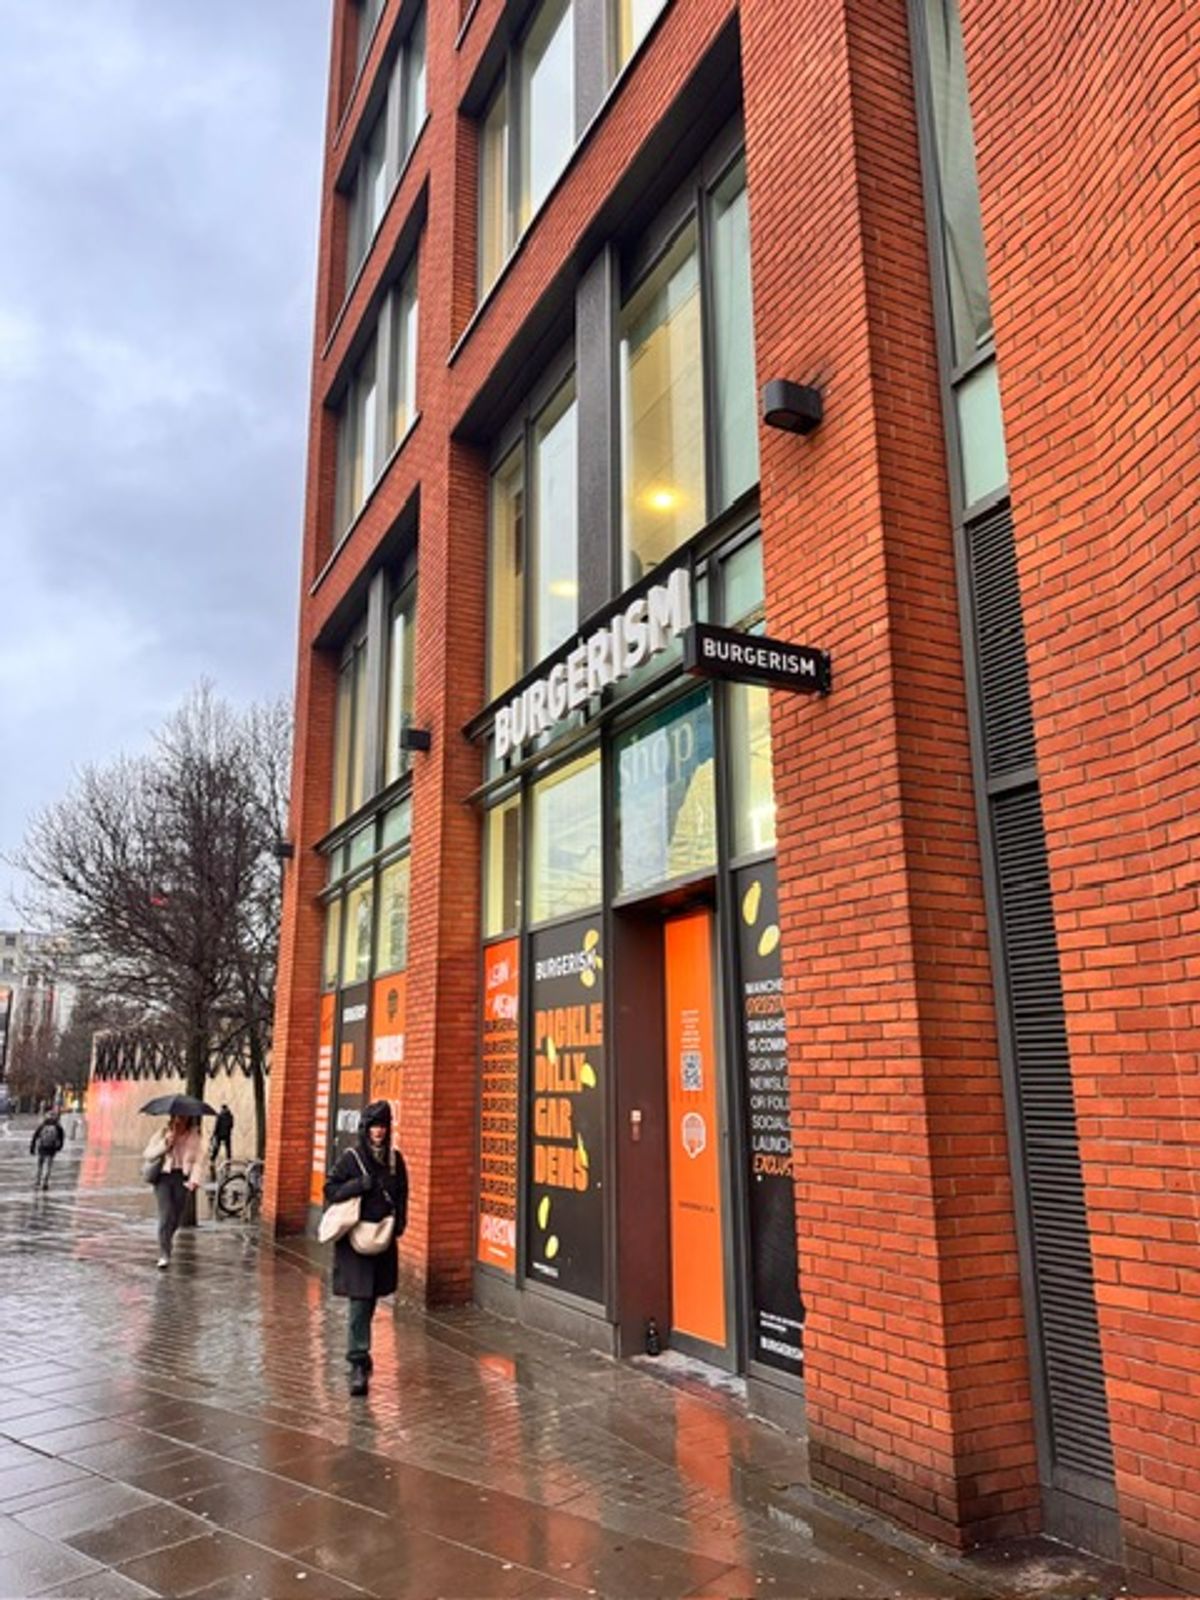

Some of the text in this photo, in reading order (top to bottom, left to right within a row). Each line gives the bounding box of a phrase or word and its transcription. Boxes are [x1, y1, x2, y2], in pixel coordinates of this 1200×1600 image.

[494, 569, 692, 760] BURGERISM
[702, 637, 817, 678] BURGERISM
[534, 949, 597, 982] BURGERISM
[534, 1002, 604, 1049] PICKLE
[534, 1053, 585, 1093] DILLY
[535, 1097, 572, 1139] GAR
[533, 1144, 590, 1192] DENS
